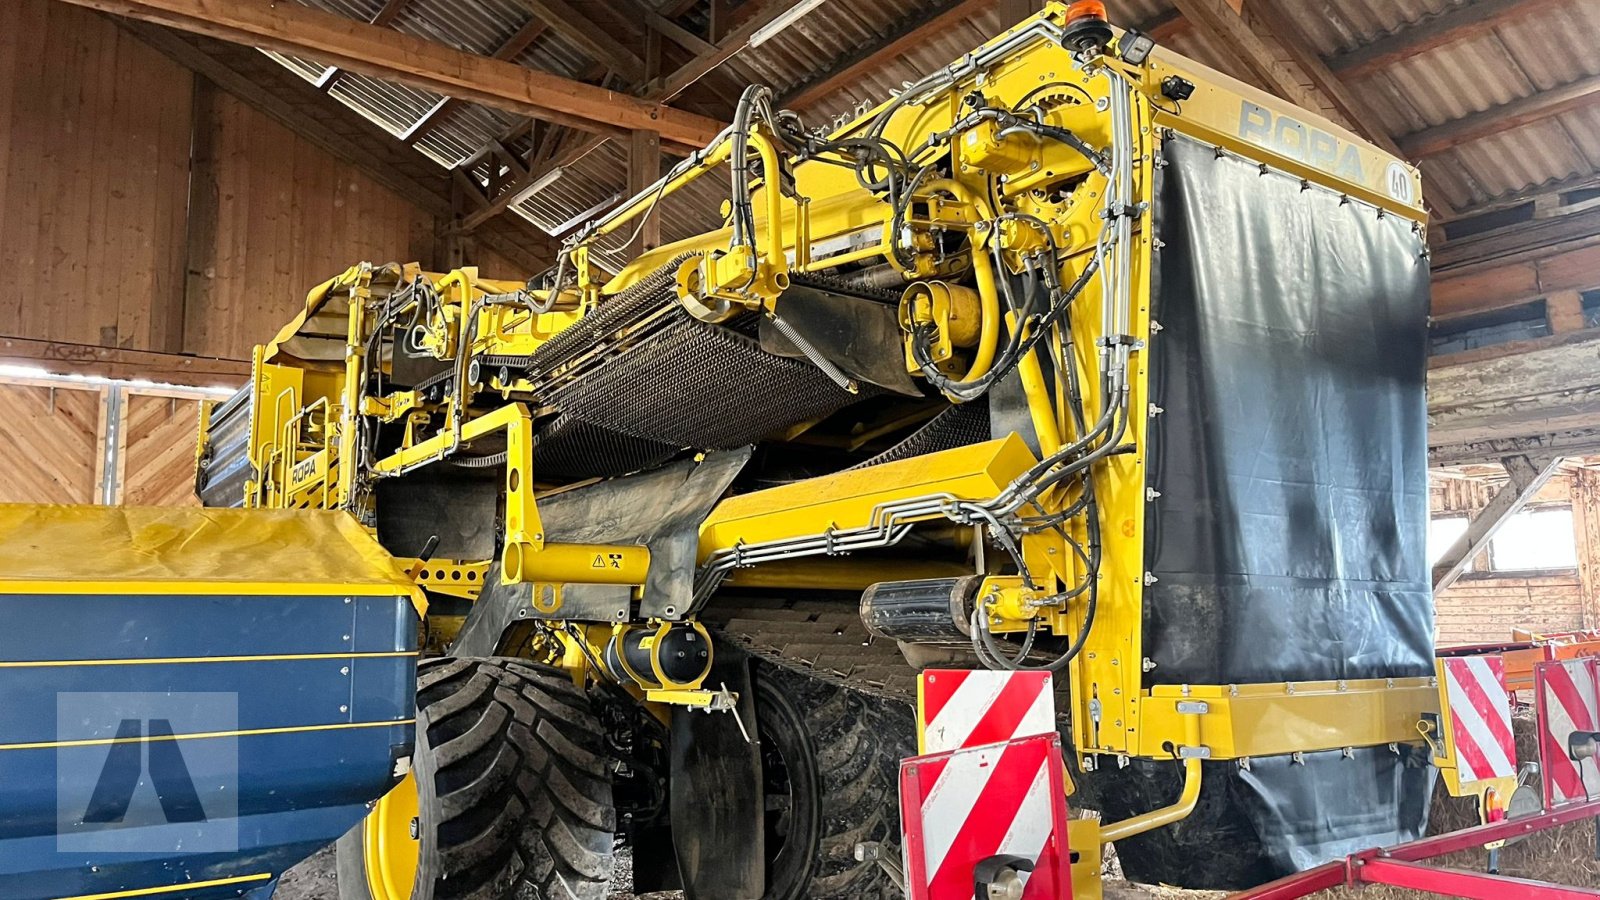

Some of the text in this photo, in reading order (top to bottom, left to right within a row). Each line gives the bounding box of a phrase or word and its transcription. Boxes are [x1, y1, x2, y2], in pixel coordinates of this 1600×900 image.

[1239, 99, 1364, 183] ROPA
[1391, 168, 1407, 200] 40
[291, 459, 316, 486] ROPA
